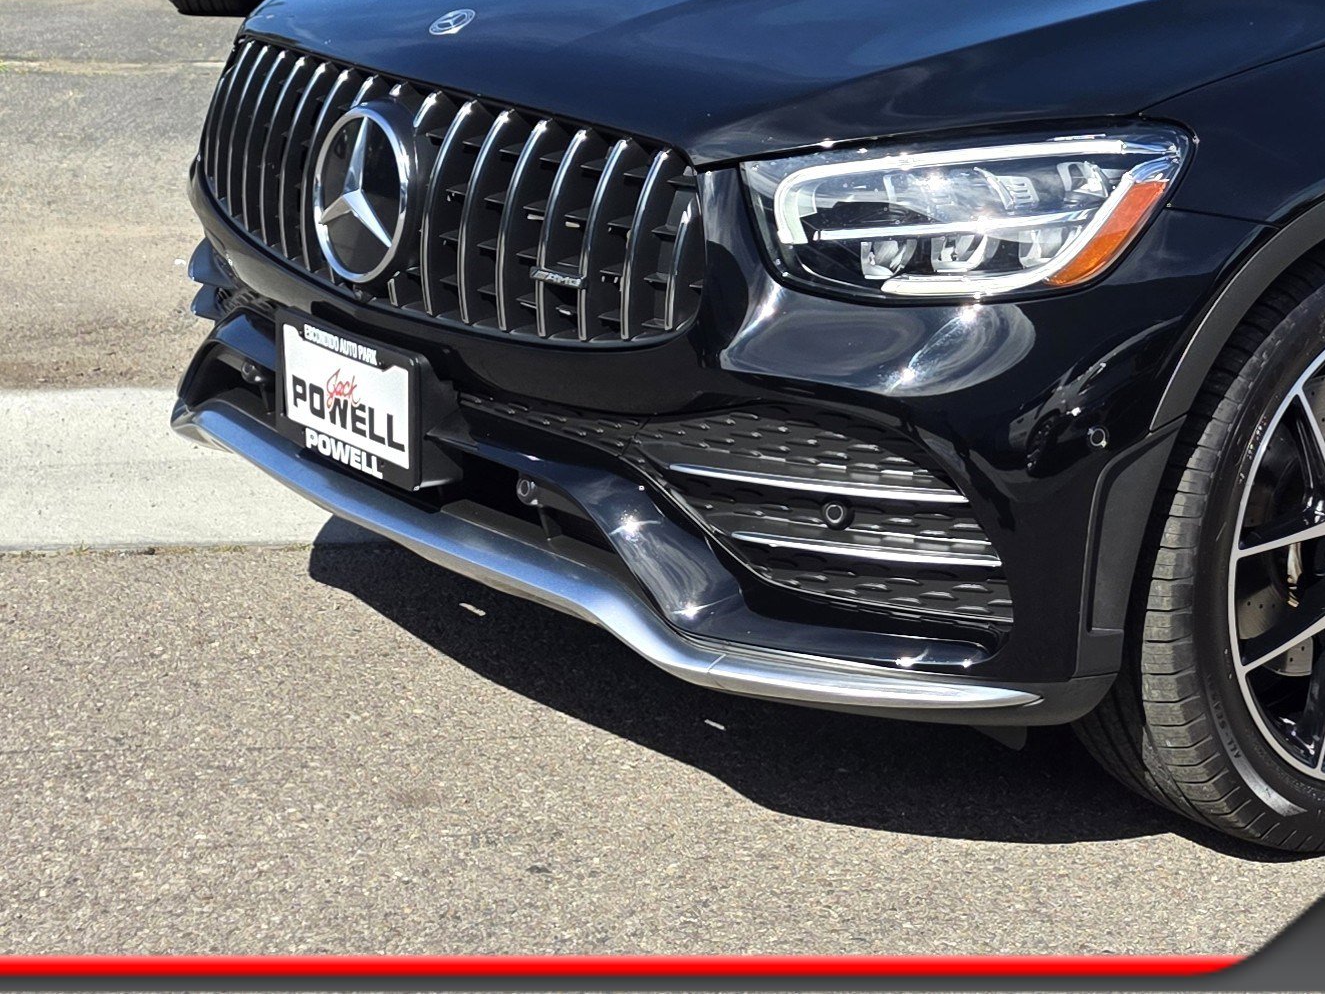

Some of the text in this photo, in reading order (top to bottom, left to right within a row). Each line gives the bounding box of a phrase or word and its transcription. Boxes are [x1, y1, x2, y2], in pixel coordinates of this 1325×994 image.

[358, 344, 377, 366] PARK
[326, 368, 361, 409] Jack
[292, 374, 406, 453] POWELL
[305, 427, 383, 480] POWELL
